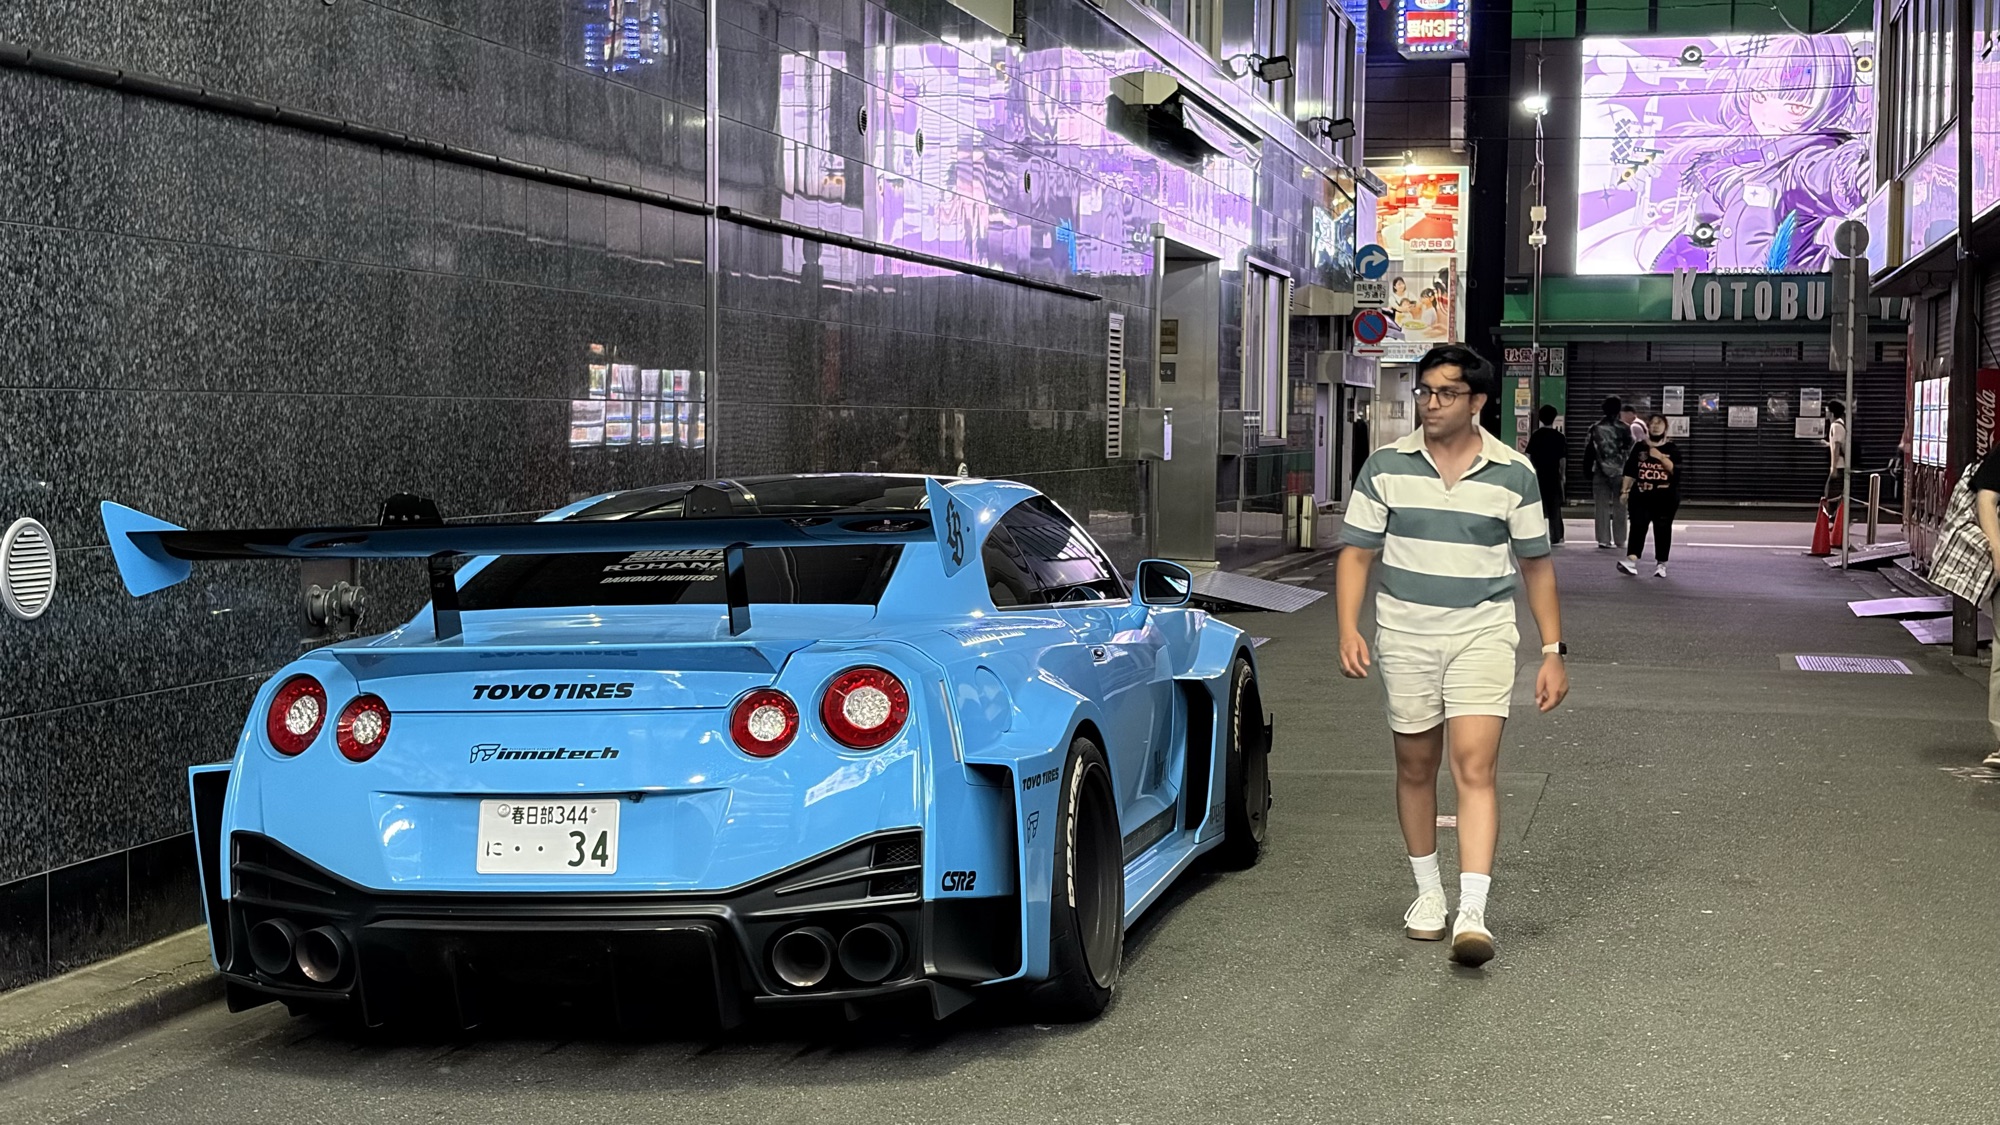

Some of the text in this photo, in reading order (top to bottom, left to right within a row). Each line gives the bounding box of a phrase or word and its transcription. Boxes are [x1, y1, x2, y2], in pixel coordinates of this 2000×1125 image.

[1406, 19, 1457, 38] 受付3F
[600, 574, 718, 584] DAIKOKU HUNTERS
[473, 682, 635, 701] TOYO TIRES
[1022, 767, 1060, 792] TOYO TIRES
[567, 830, 609, 868] 34
[941, 870, 977, 892] CSR2
